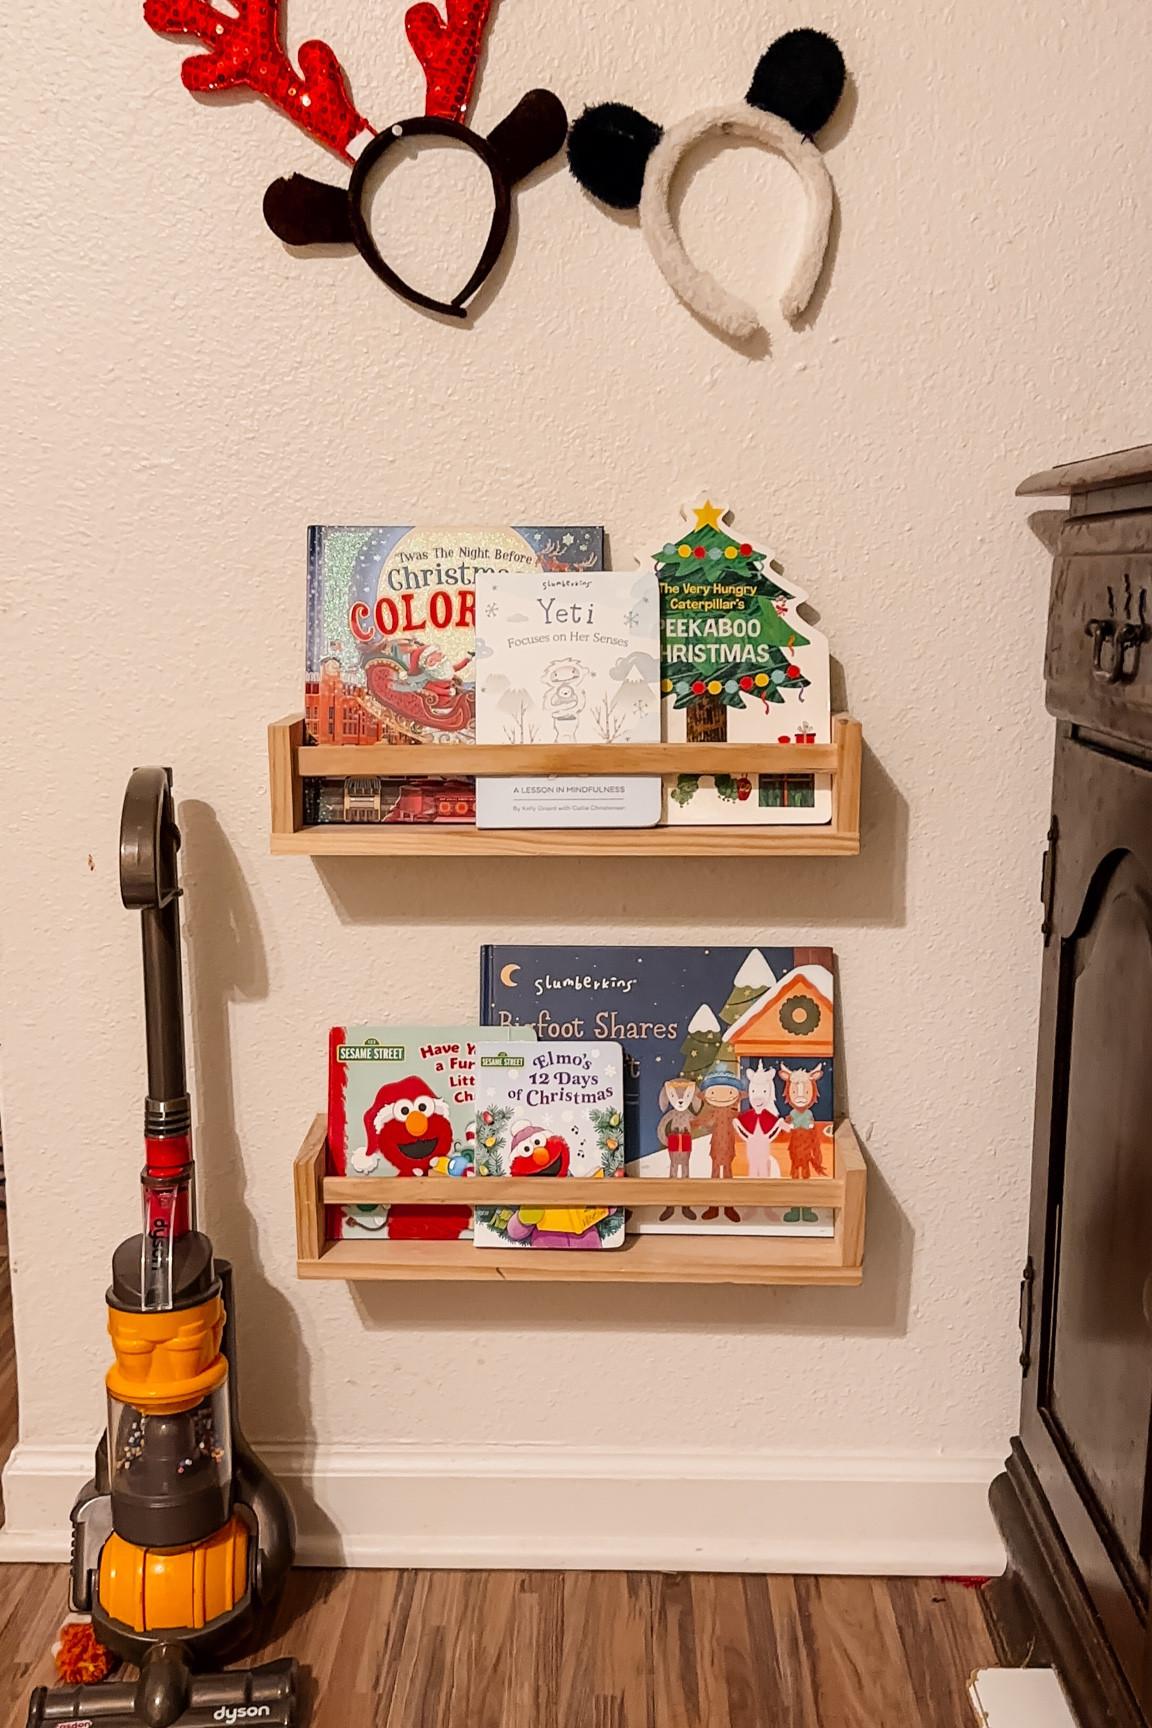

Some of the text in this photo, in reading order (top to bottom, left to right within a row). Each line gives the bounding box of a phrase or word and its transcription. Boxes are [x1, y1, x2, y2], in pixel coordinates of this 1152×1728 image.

[433, 547, 454, 558] The
[459, 547, 490, 560] Night
[494, 548, 533, 564] Before
[387, 562, 523, 591] Christ
[659, 583, 757, 596] The Very Hungry
[537, 598, 594, 624] Yeti
[670, 598, 745, 612] Caterpillar's
[507, 632, 629, 648] Focuses on Her Senses
[660, 644, 770, 662] HRISTMAS
[521, 786, 554, 794] LESSON
[534, 975, 633, 996] slumberkins
[498, 1010, 678, 1039] Bifoot Shares
[340, 1047, 403, 1059] SESAME STREET
[420, 1043, 460, 1058] Have
[435, 1058, 475, 1071] a Fur
[482, 1057, 523, 1066] SESAME STREET
[532, 1051, 593, 1070] Elmo's
[450, 1075, 475, 1087] Litt
[529, 1071, 599, 1089] 12 Days
[454, 1090, 474, 1103] Ch
[507, 1086, 613, 1107] of Christmas
[213, 1705, 270, 1724] dyson
